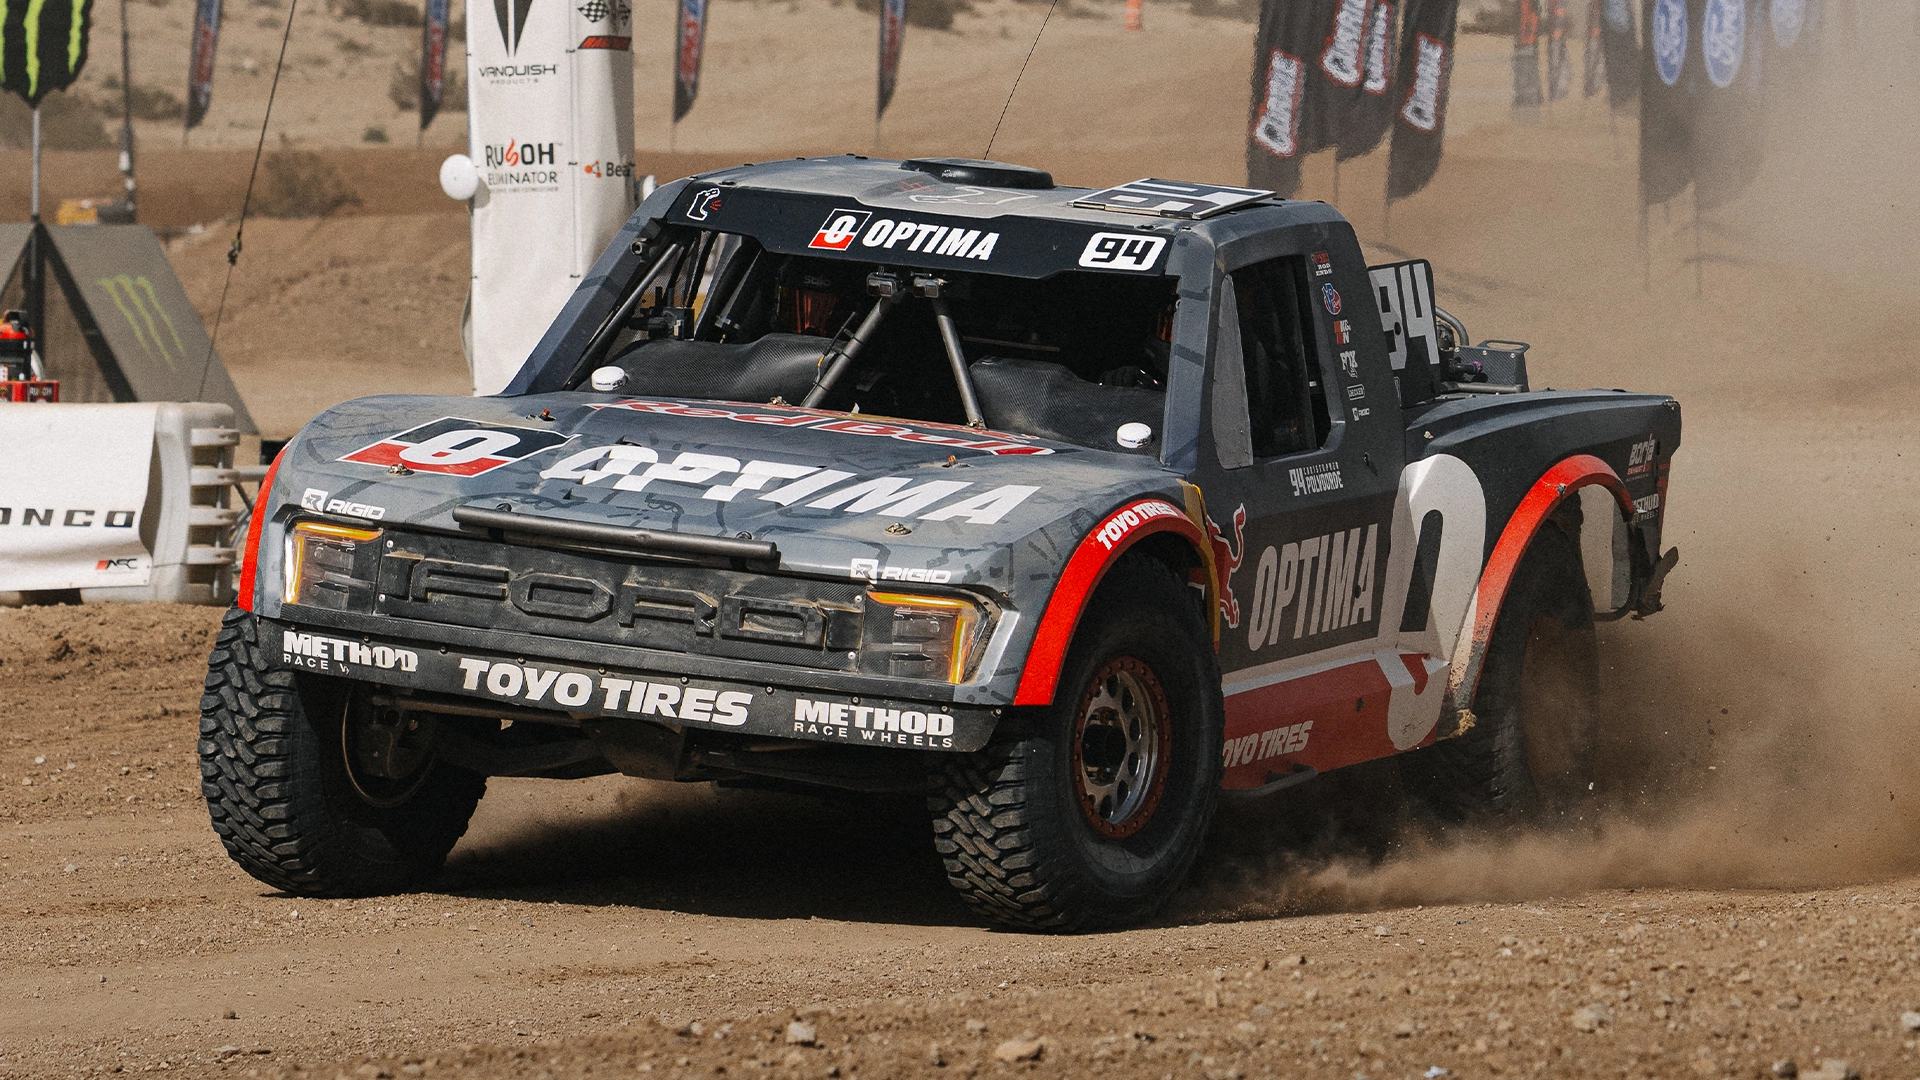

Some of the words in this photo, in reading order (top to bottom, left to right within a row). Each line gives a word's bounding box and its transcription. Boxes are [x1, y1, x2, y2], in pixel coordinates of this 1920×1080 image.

[479, 64, 556, 77] VANQUISH
[862, 219, 1000, 261] OPTIMA
[1091, 237, 1157, 266] 94
[584, 398, 834, 428] Red
[808, 418, 1055, 456] Bull
[540, 444, 1042, 525] OPTIMA
[1289, 468, 1307, 497] 94
[326, 498, 386, 520] RIGID
[1096, 510, 1140, 550] TOYO
[881, 566, 952, 583] RIGID
[1248, 522, 1379, 652] OPTIMA
[409, 556, 827, 651] FORD
[283, 629, 419, 673] METHOD
[283, 653, 329, 670] RACE
[458, 657, 594, 707] TOYO
[600, 676, 754, 727] TIRES
[794, 698, 955, 738] METHOD
[794, 721, 848, 740] RACE
[860, 728, 954, 748] WHEELS
[1222, 732, 1260, 768] OYO
[1257, 720, 1314, 761] TIRES
